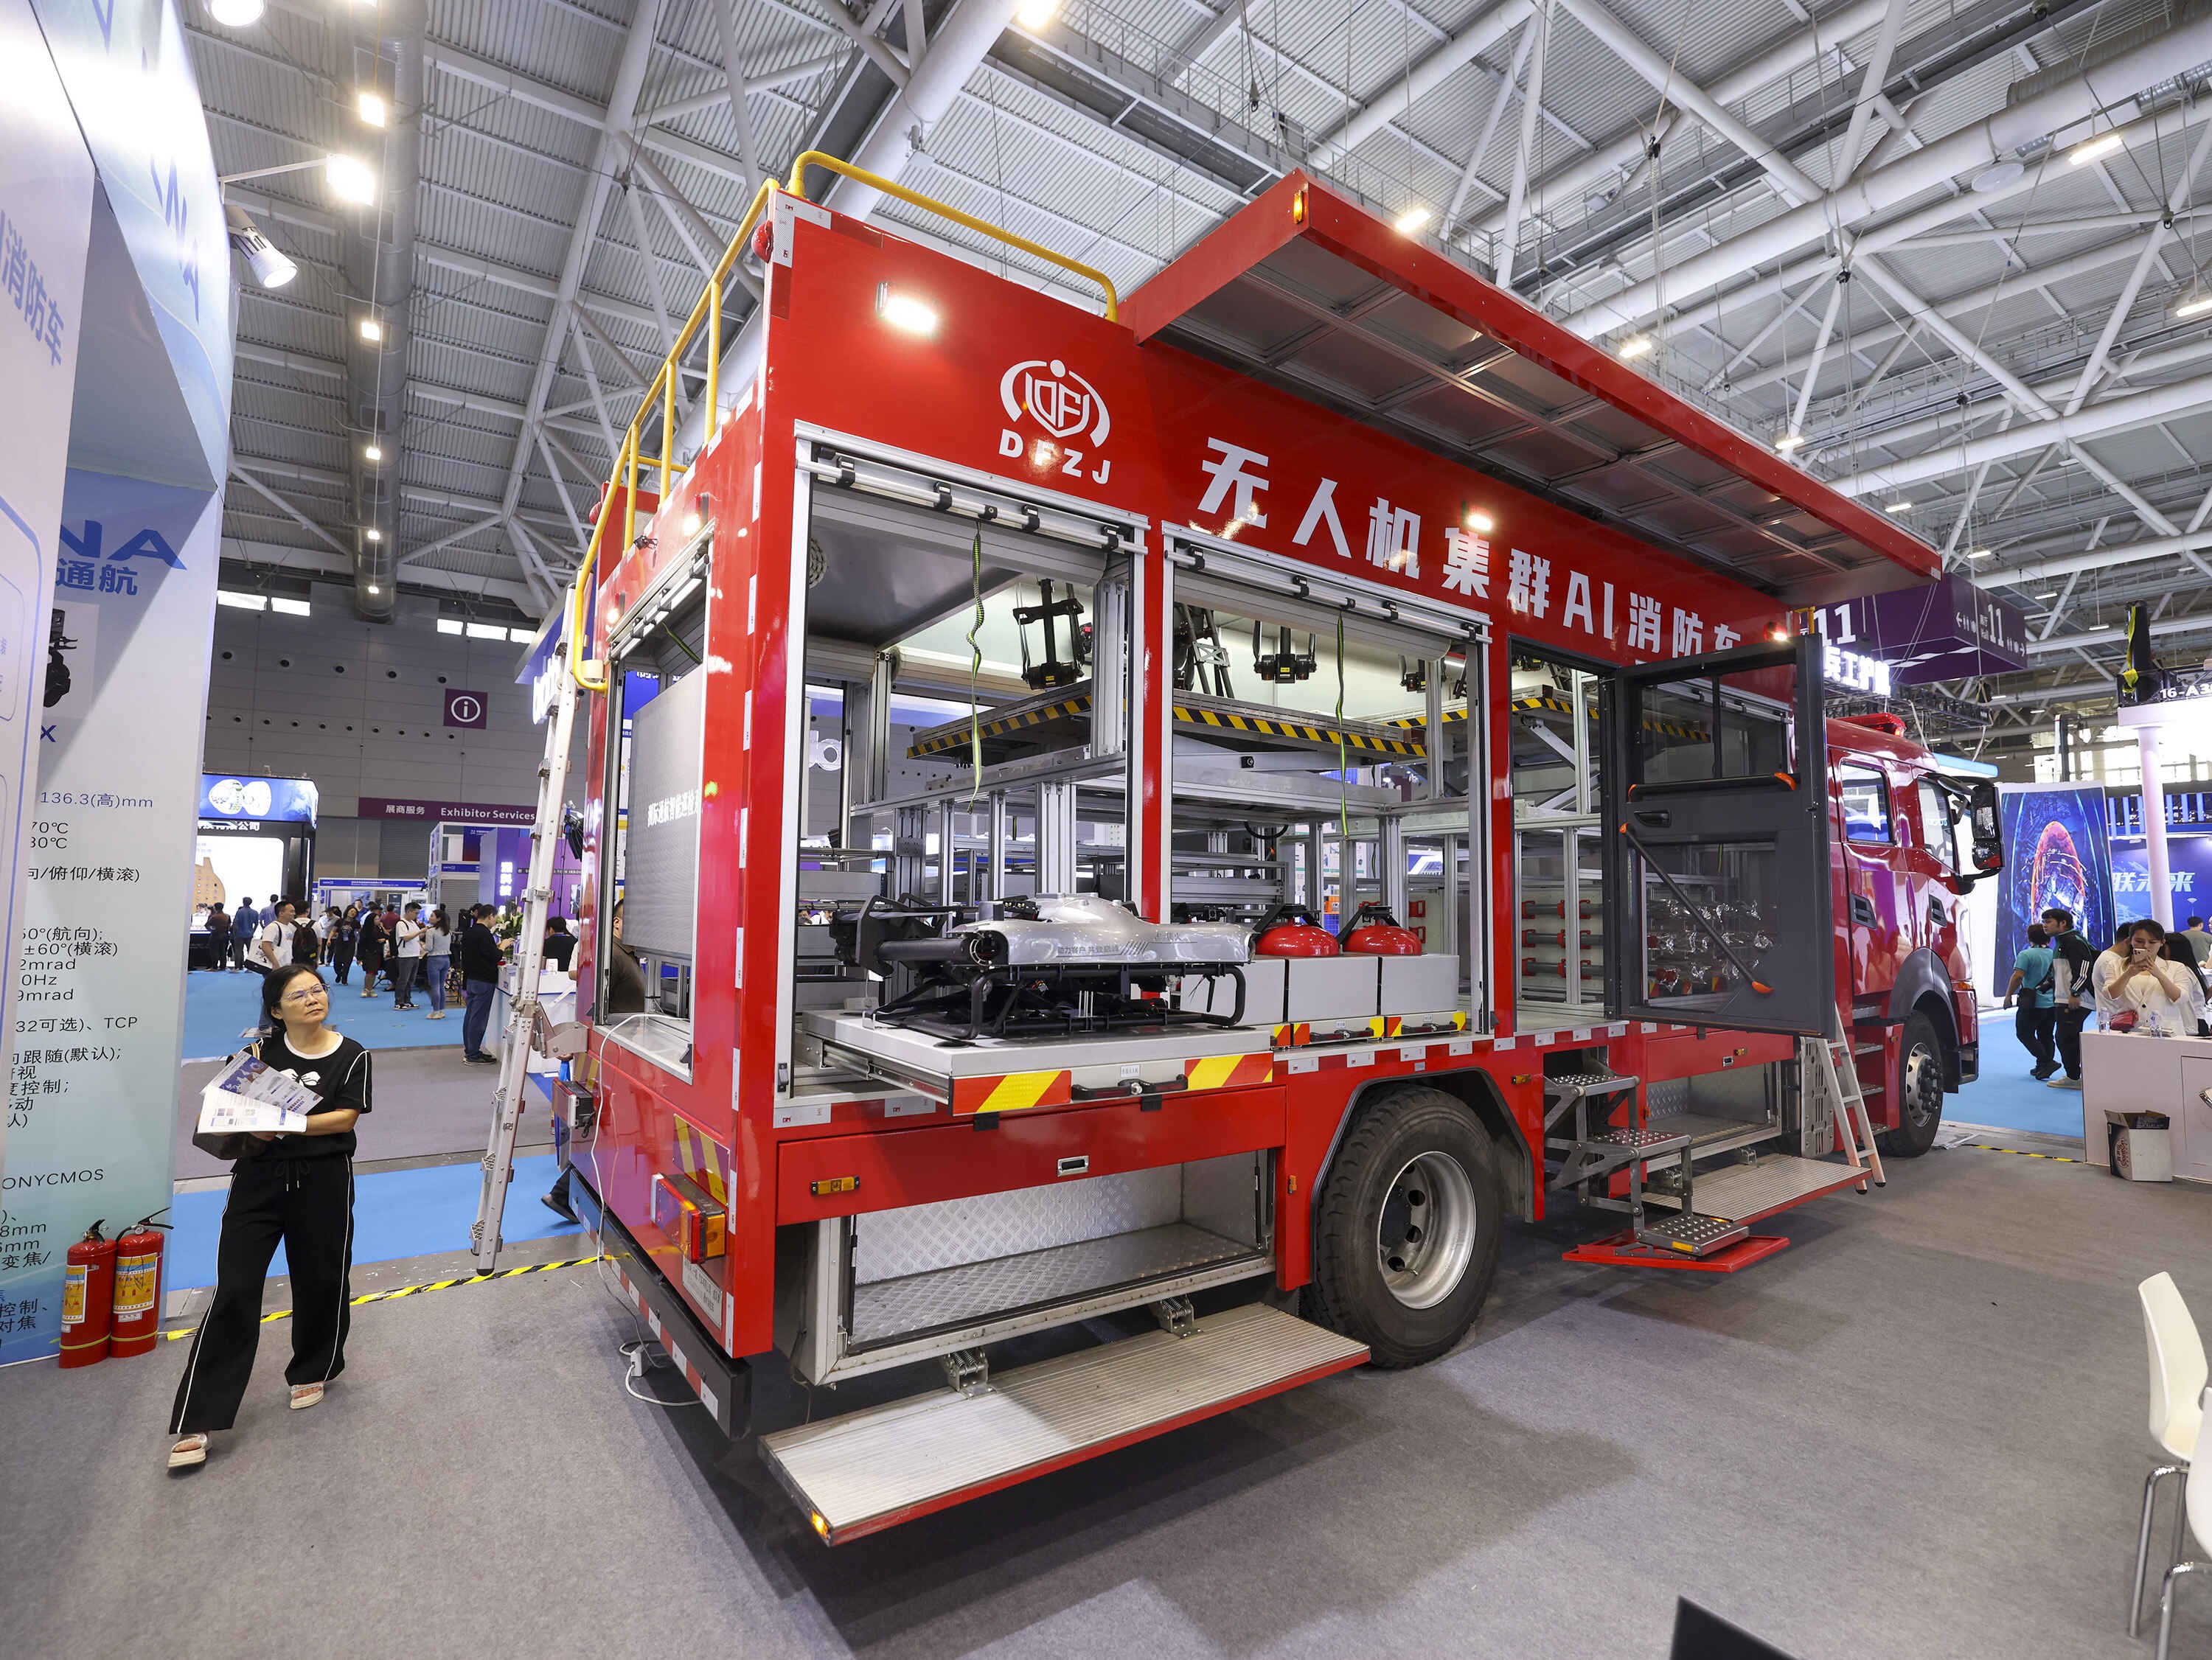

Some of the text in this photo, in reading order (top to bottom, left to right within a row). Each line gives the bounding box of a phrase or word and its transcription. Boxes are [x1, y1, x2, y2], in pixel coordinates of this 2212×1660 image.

[0, 210, 64, 366] 消防车
[386, 804, 425, 815] 展商服务
[441, 807, 535, 820] Exhibitor Services
[10, 1065, 36, 1081] 视
